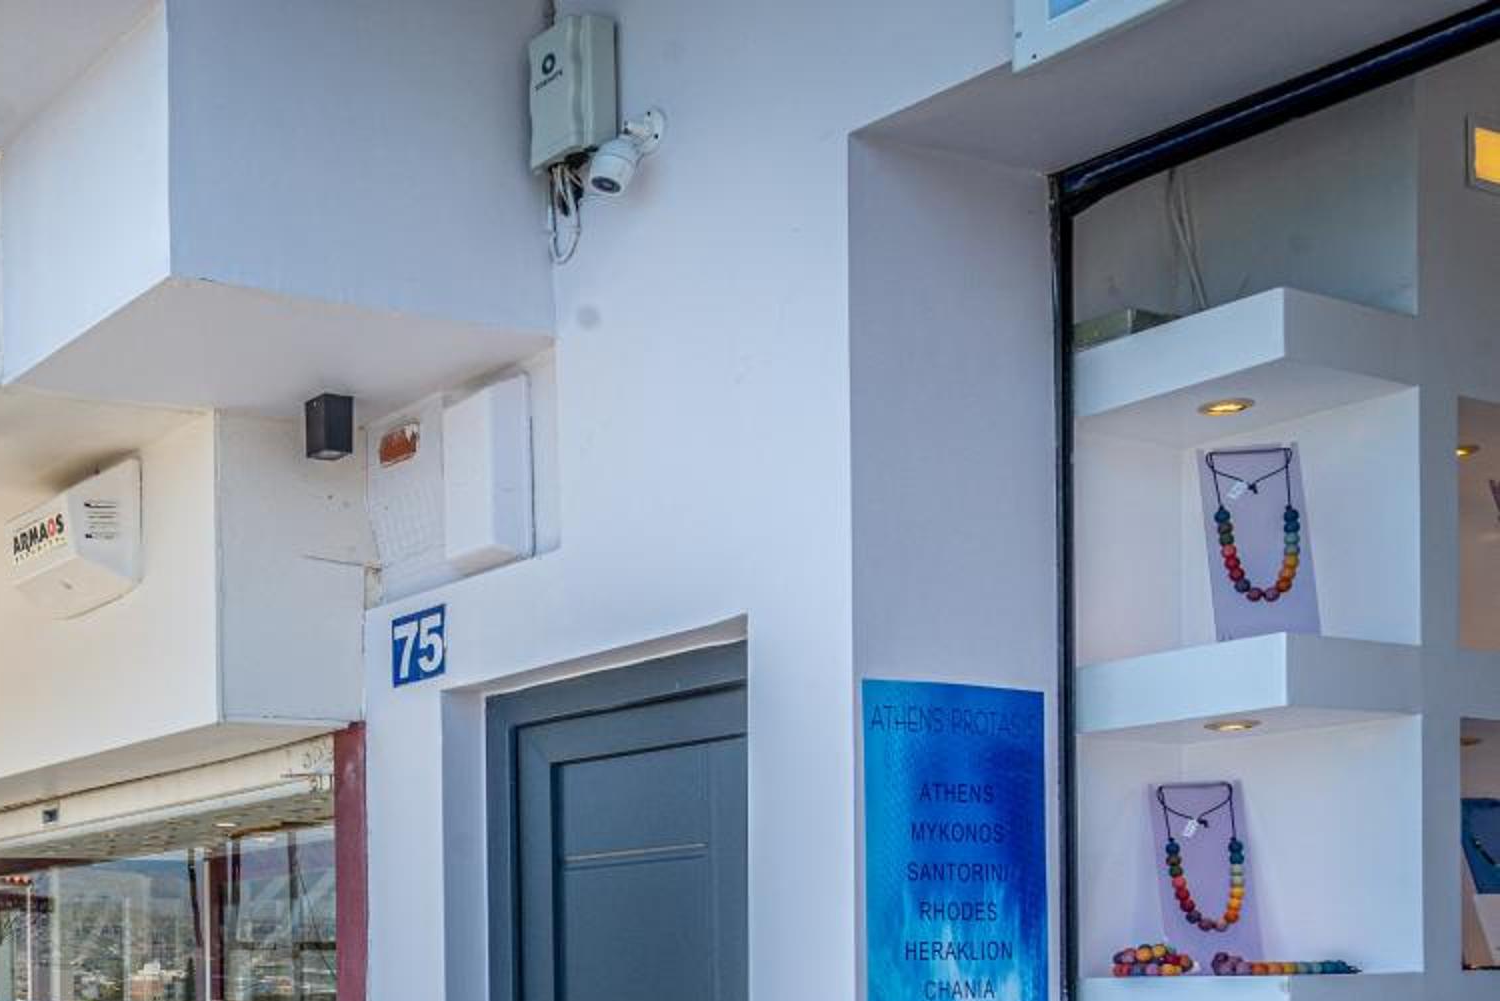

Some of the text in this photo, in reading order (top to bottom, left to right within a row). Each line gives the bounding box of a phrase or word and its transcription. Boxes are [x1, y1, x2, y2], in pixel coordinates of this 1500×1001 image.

[12, 513, 65, 555] ARMAOS
[393, 612, 444, 680] 75
[869, 704, 946, 733] ATHENS
[919, 783, 996, 804] ATHENS
[910, 821, 1005, 844] MYKONOS
[906, 861, 1010, 882] SANTORINI
[919, 901, 997, 921] RHODES
[905, 940, 1013, 961] HERAKLION
[924, 979, 996, 1001] CHANIA
